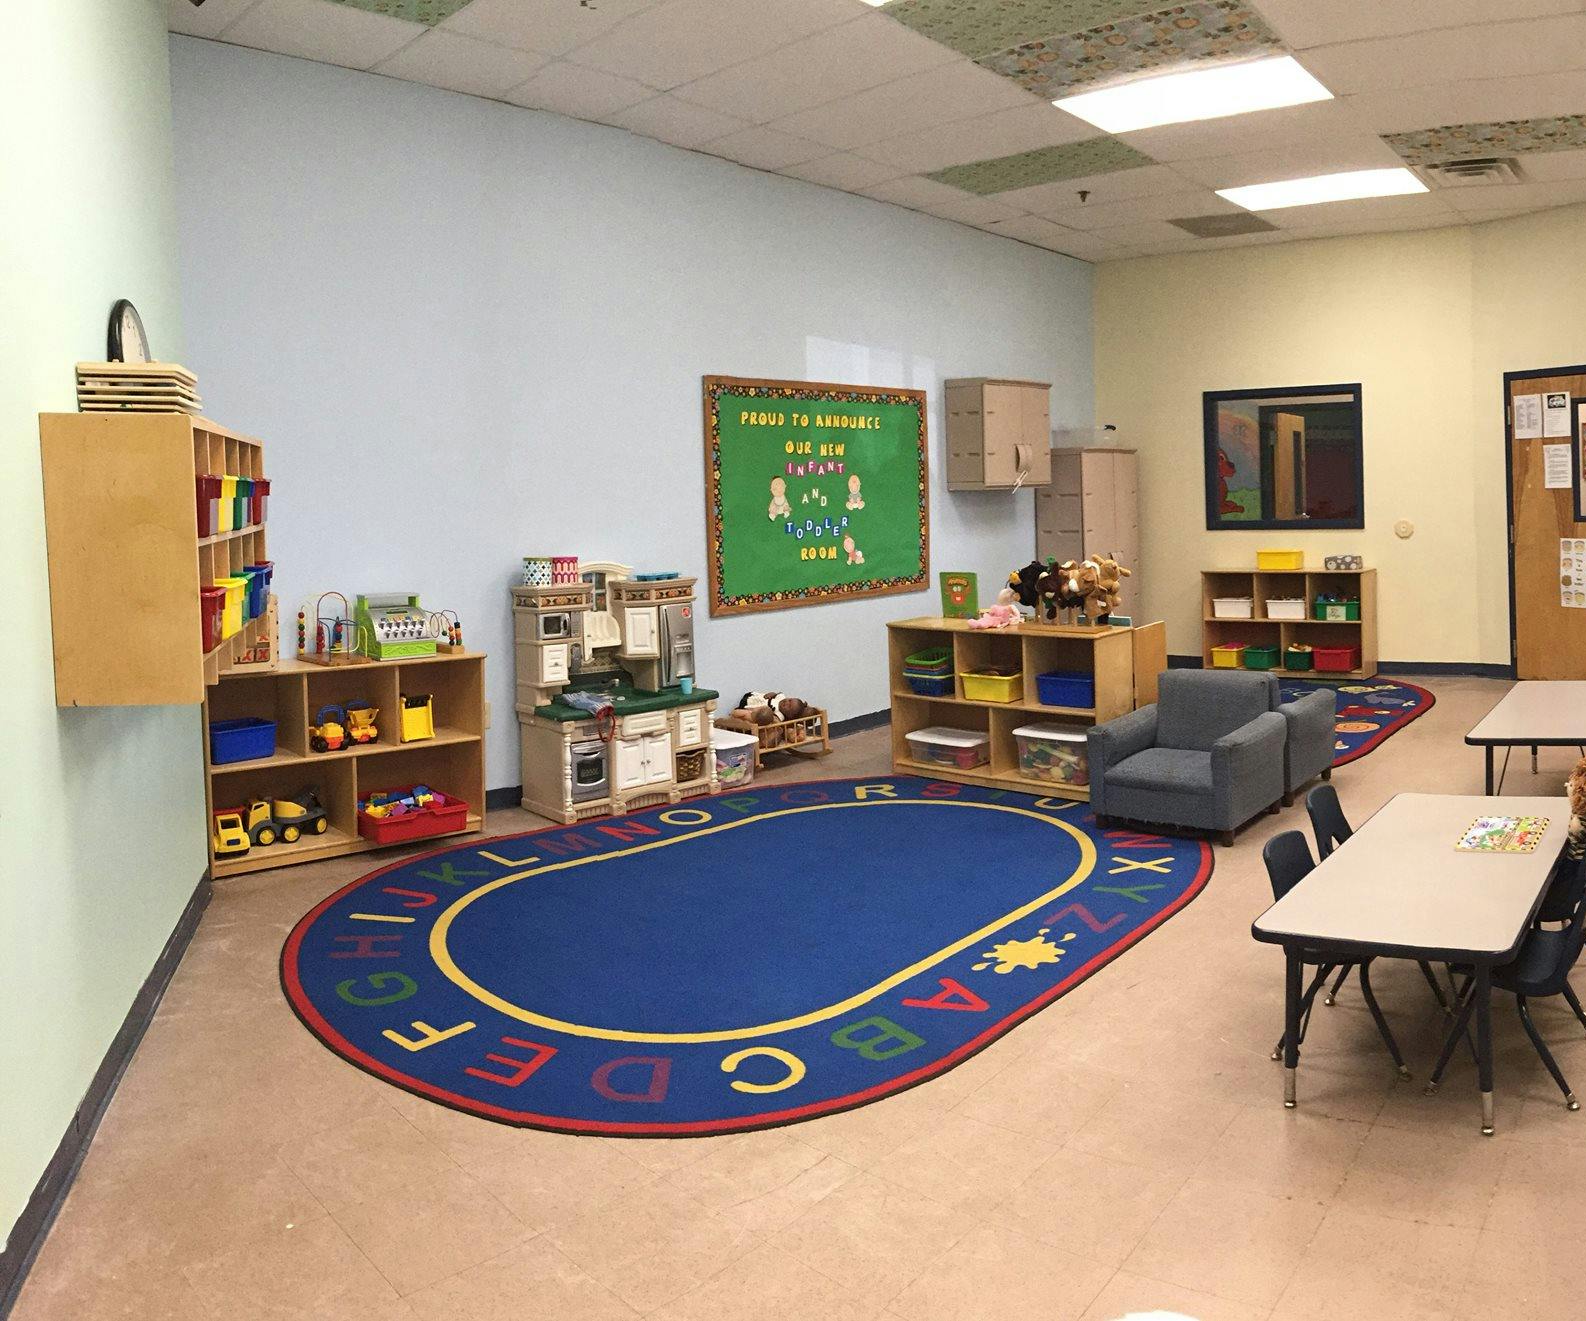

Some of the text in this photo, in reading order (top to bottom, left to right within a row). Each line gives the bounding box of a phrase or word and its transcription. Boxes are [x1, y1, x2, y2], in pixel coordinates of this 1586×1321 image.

[741, 411, 881, 430] PROUD TO ANNOUNCE
[785, 440, 845, 457] OUR NEW
[787, 461, 844, 477] INFANT
[802, 488, 827, 507] AND
[786, 516, 848, 538] TODDLER
[801, 547, 837, 561] ROOM
[854, 784, 898, 800] R
[659, 809, 712, 825] O
[596, 820, 662, 842] N
[531, 832, 599, 856] M
[477, 849, 541, 867] L
[1108, 856, 1175, 874] X
[417, 862, 491, 887] K
[382, 887, 438, 908] J
[1092, 884, 1166, 902] Y
[349, 913, 416, 923] I
[1043, 903, 1129, 933] Z
[331, 935, 401, 959] H
[335, 971, 418, 1007] G
[901, 978, 990, 1012] A
[382, 1020, 477, 1052] F
[830, 1015, 927, 1061] B
[465, 1036, 559, 1087] E
[721, 1046, 806, 1094] C
[591, 1055, 673, 1102] D
